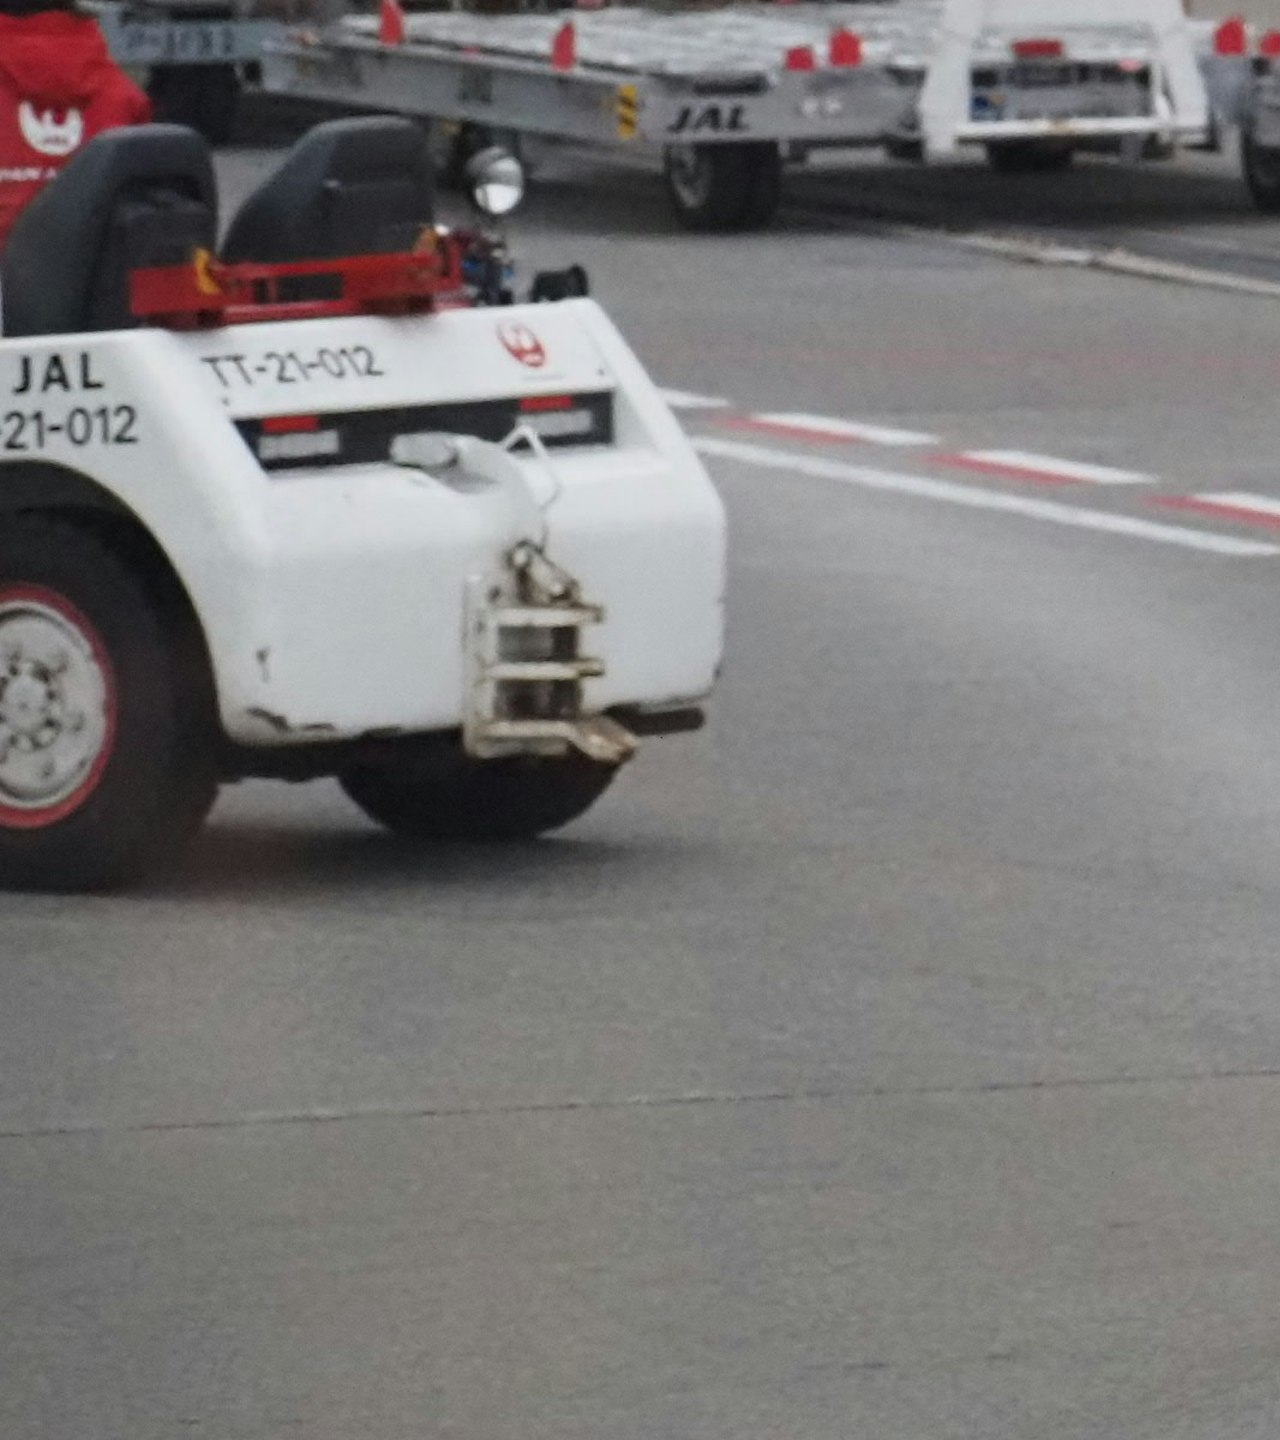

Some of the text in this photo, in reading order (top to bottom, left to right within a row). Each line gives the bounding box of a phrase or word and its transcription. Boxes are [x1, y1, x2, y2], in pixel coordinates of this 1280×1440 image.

[666, 103, 751, 134] JAL
[12, 352, 106, 394] JAL
[201, 345, 384, 388] TT-21-012
